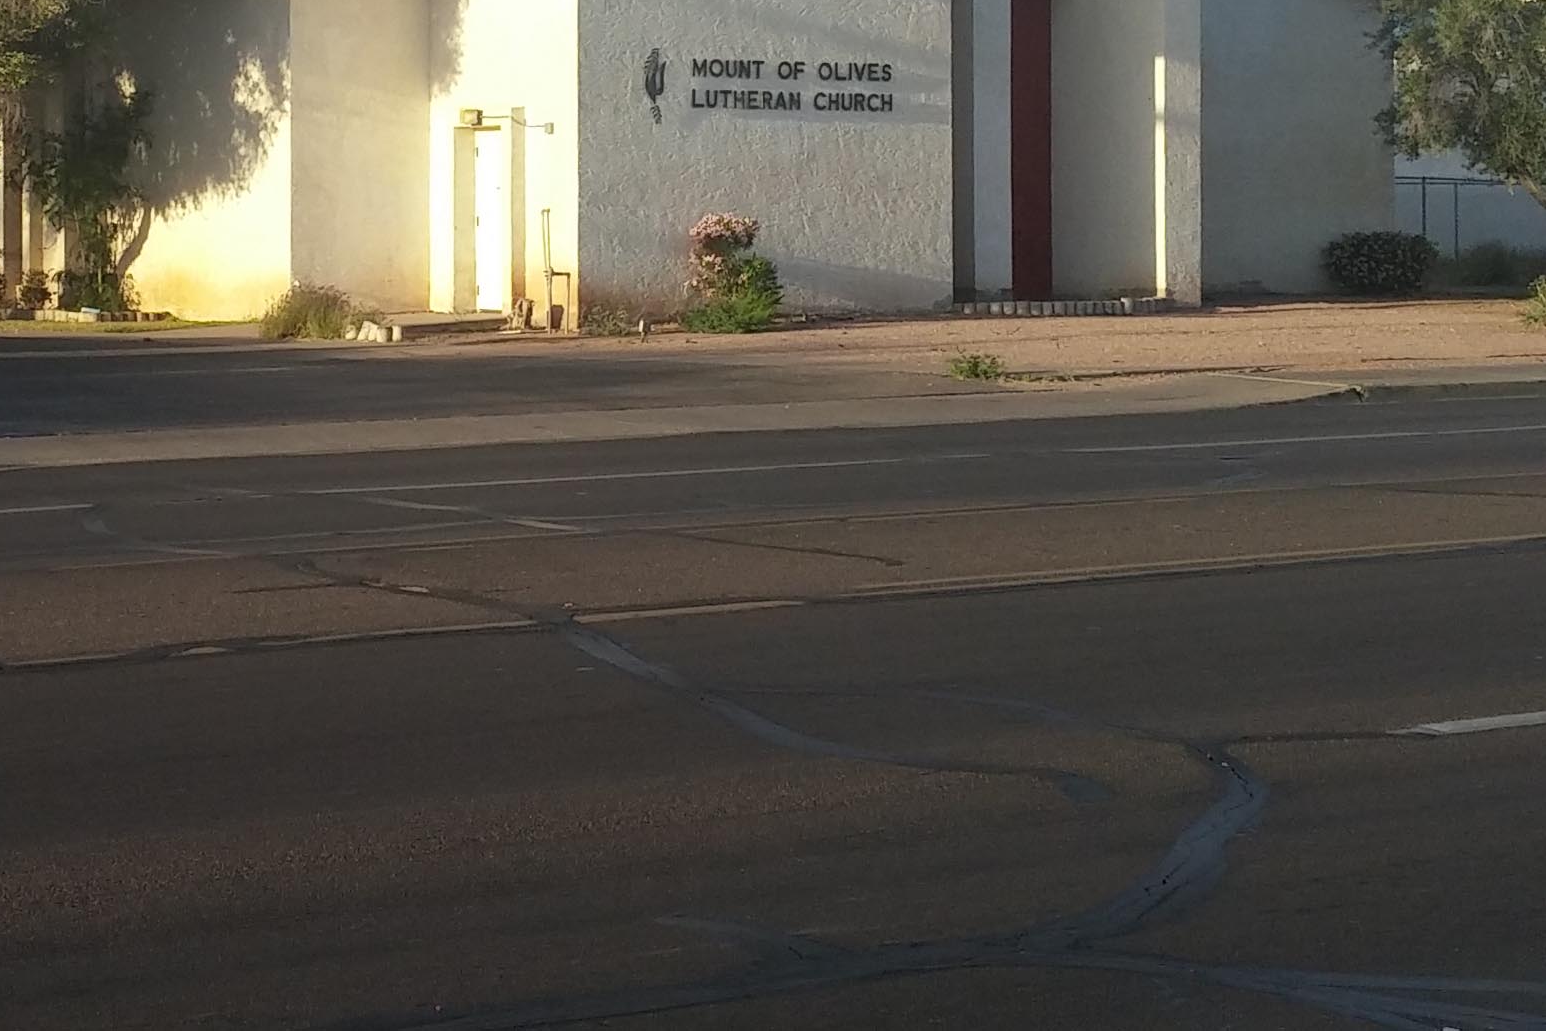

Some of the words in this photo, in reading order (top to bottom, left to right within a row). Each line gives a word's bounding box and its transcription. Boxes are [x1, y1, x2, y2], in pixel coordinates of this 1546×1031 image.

[691, 58, 765, 80] MOUNT
[777, 61, 806, 80] OF
[818, 61, 893, 82] OLIVES
[691, 88, 802, 111] LUTHERAN
[813, 92, 894, 113] CHURCH
